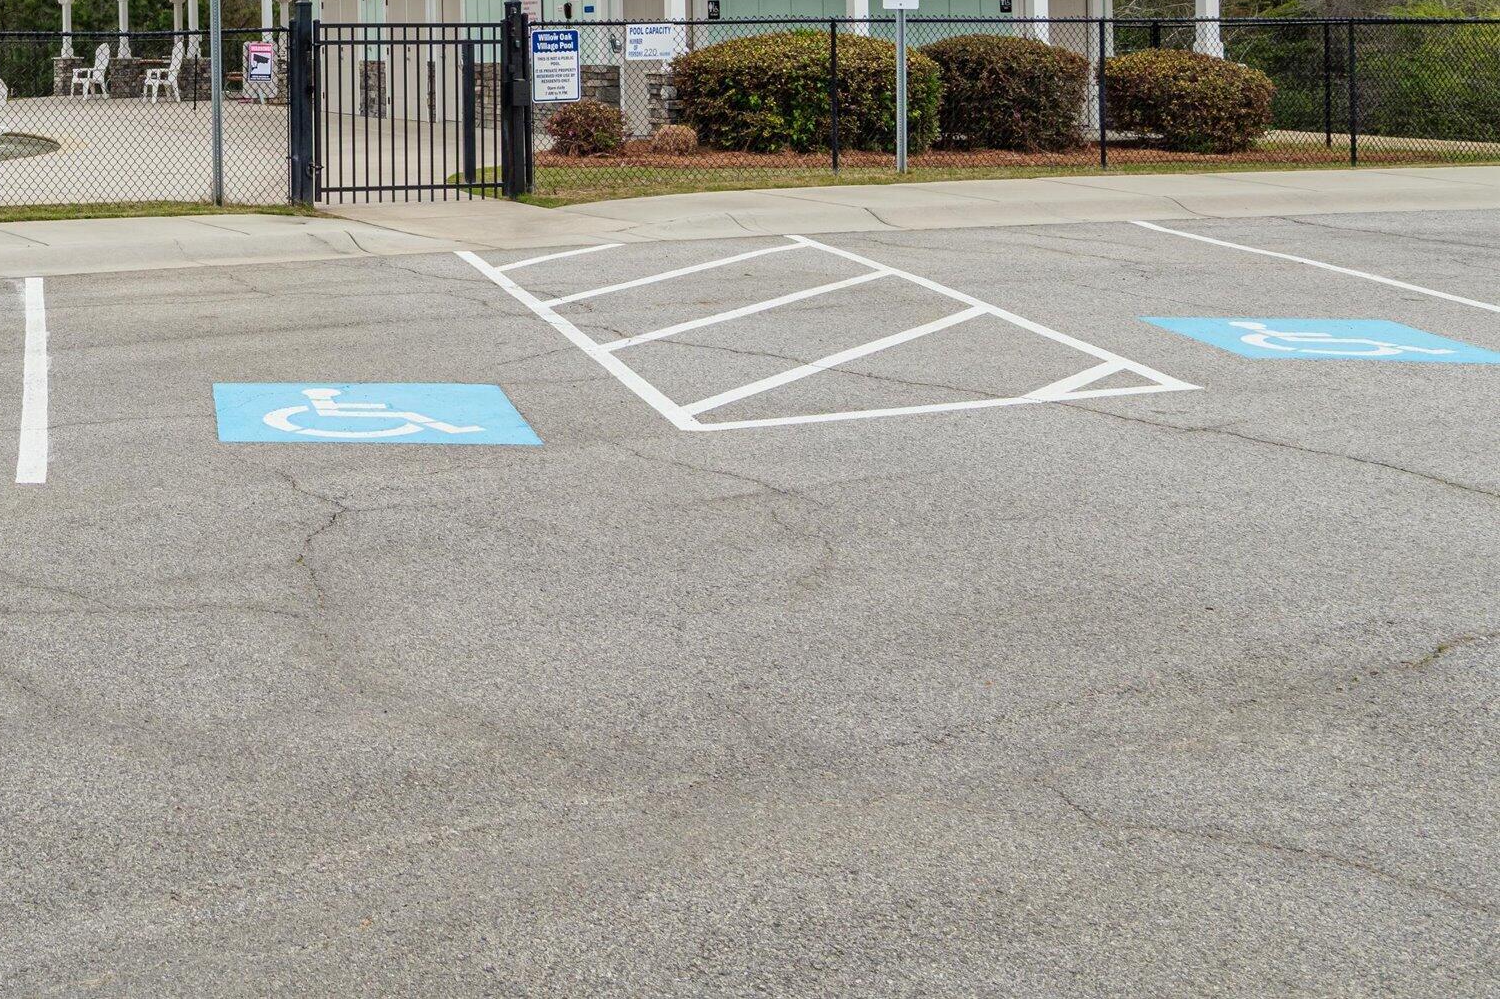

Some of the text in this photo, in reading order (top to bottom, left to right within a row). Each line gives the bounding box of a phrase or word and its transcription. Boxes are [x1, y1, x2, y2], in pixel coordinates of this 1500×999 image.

[630, 26, 671, 35] POOL CAPACITY
[538, 32, 572, 41] Willow Oak
[536, 42, 558, 51] Village
